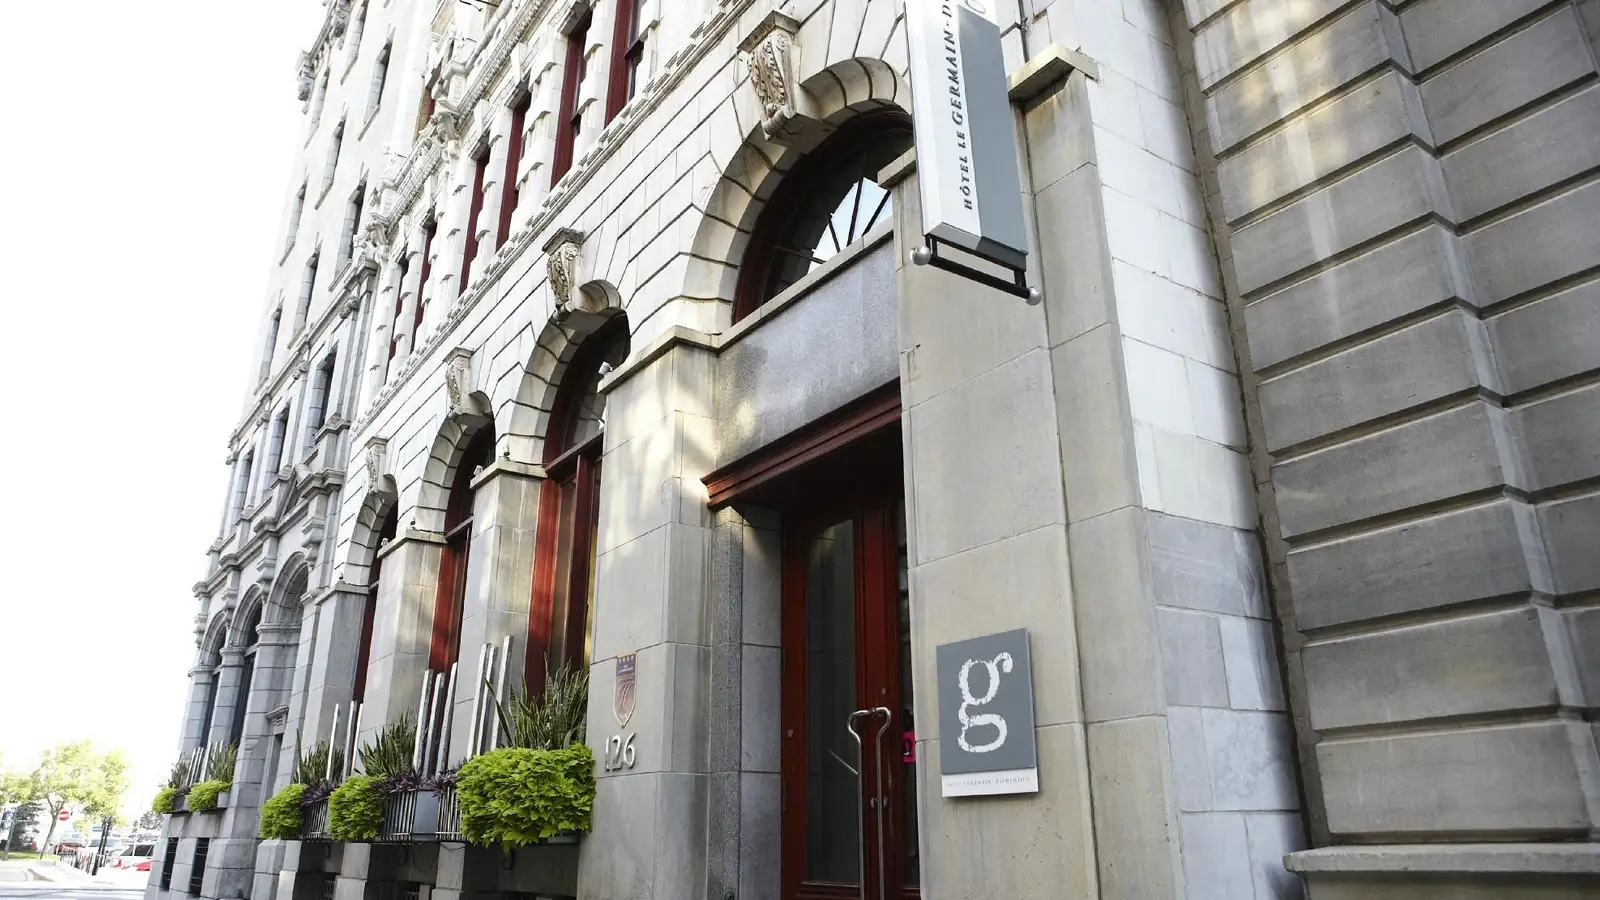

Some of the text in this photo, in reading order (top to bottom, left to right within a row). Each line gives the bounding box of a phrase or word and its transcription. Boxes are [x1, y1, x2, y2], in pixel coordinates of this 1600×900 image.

[956, 131, 967, 149] LE
[959, 155, 973, 210] HÔTEL
[957, 651, 1014, 753] g
[605, 732, 636, 772] 126
